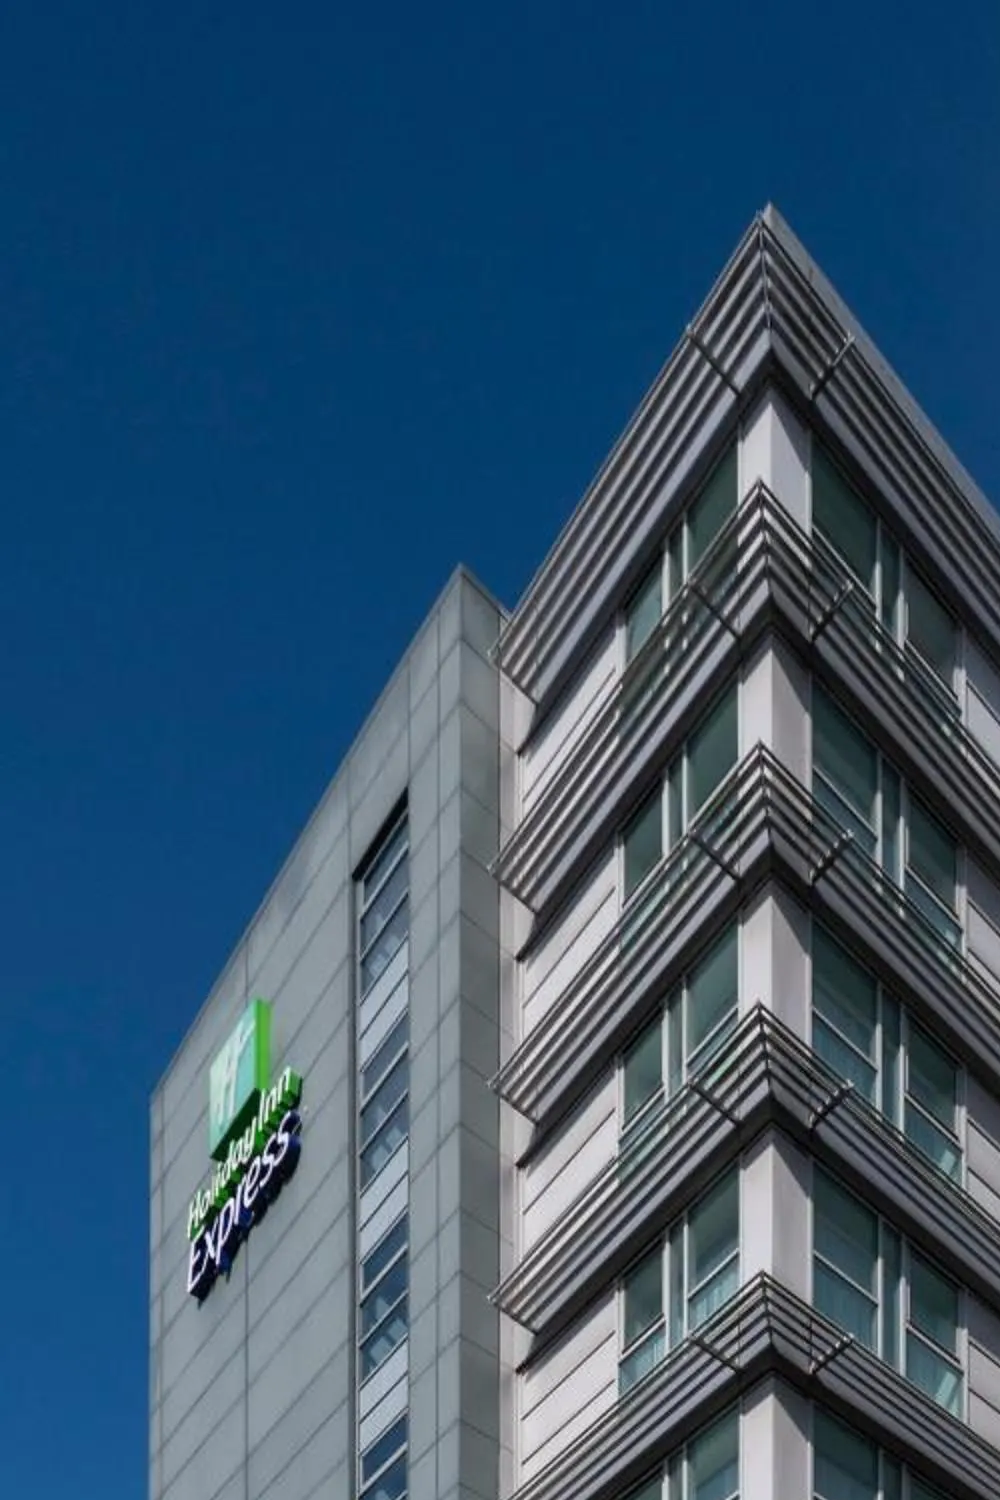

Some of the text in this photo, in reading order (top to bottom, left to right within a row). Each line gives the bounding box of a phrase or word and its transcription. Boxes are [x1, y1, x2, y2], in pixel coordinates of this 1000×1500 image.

[186, 1110, 302, 1293] Express
[187, 1066, 292, 1240] Holiday Inn
